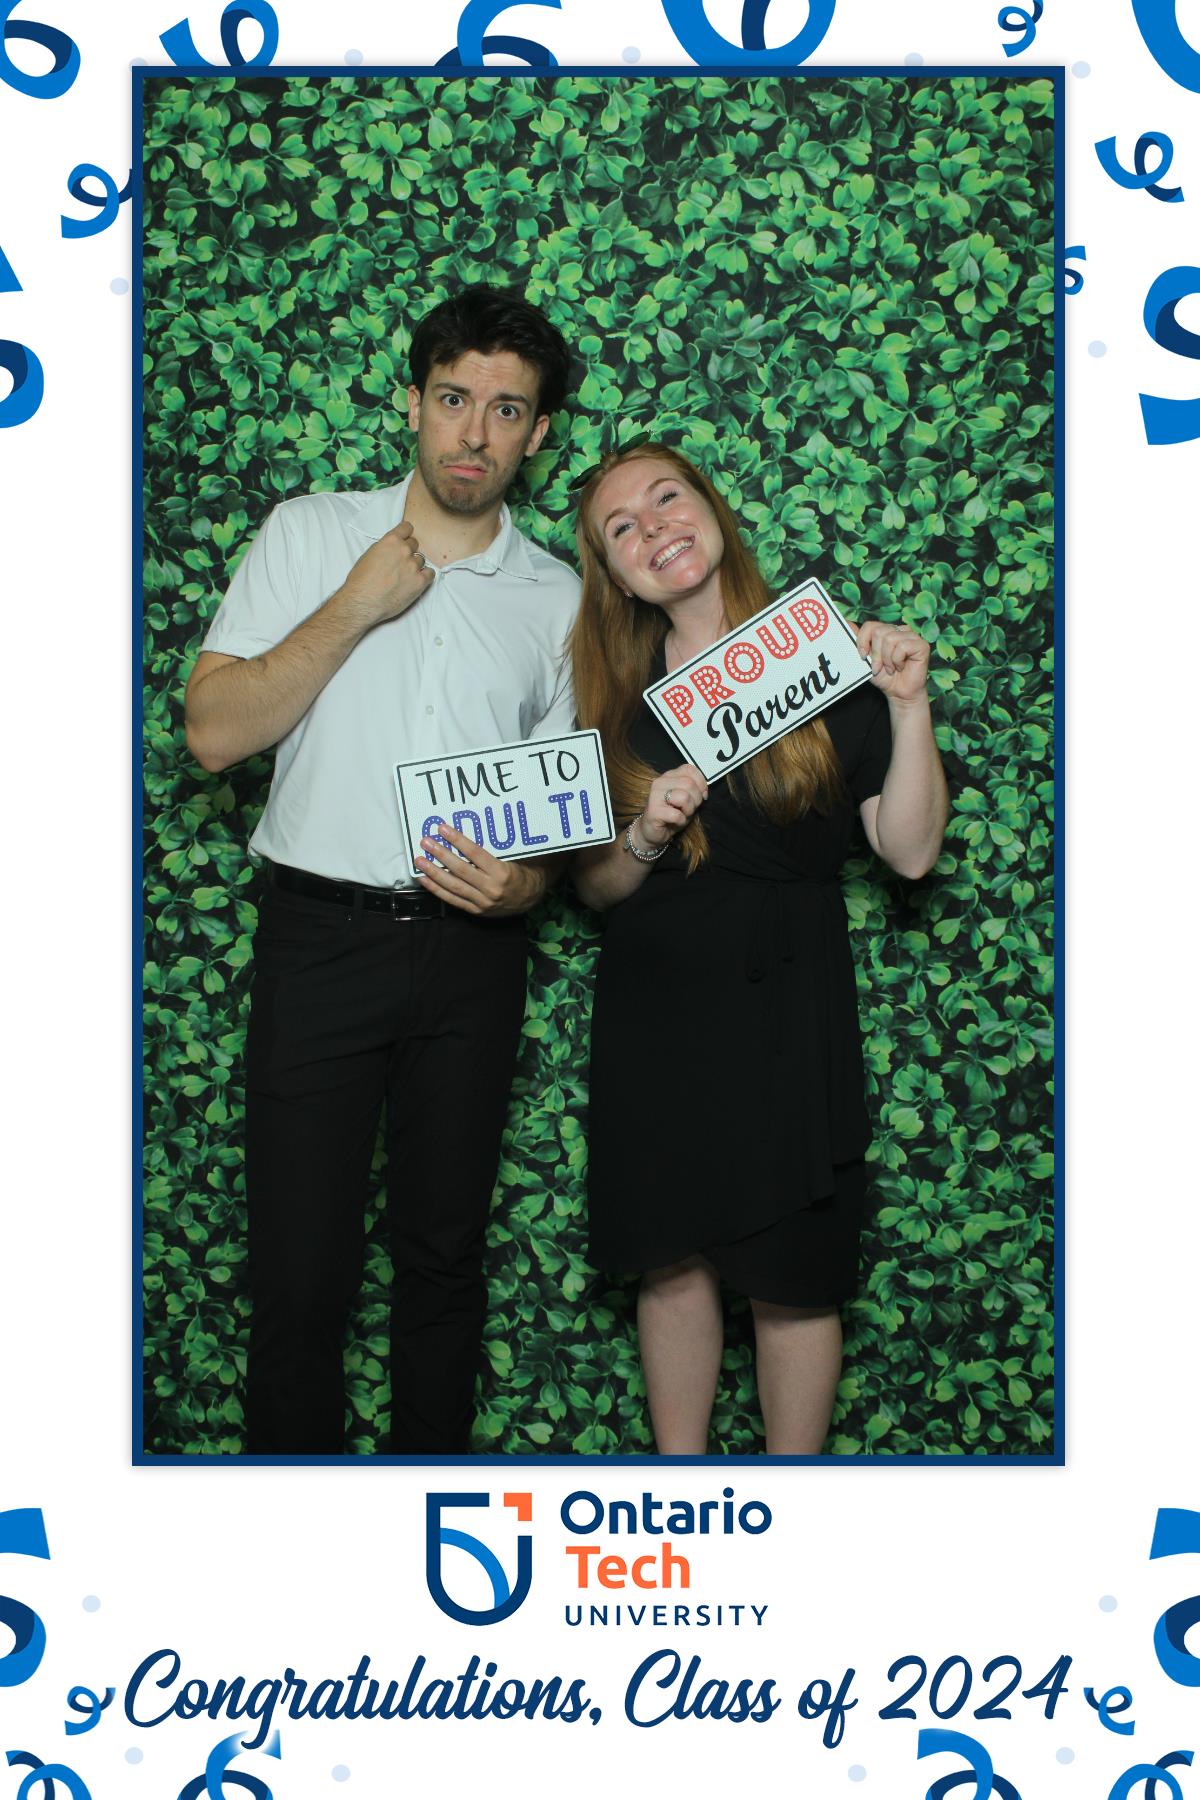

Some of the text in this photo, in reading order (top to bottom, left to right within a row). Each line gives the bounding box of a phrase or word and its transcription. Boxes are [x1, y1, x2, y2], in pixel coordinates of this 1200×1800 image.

[661, 598, 829, 728] PROUD
[706, 652, 841, 762] Parent
[415, 749, 580, 806] TIME TO
